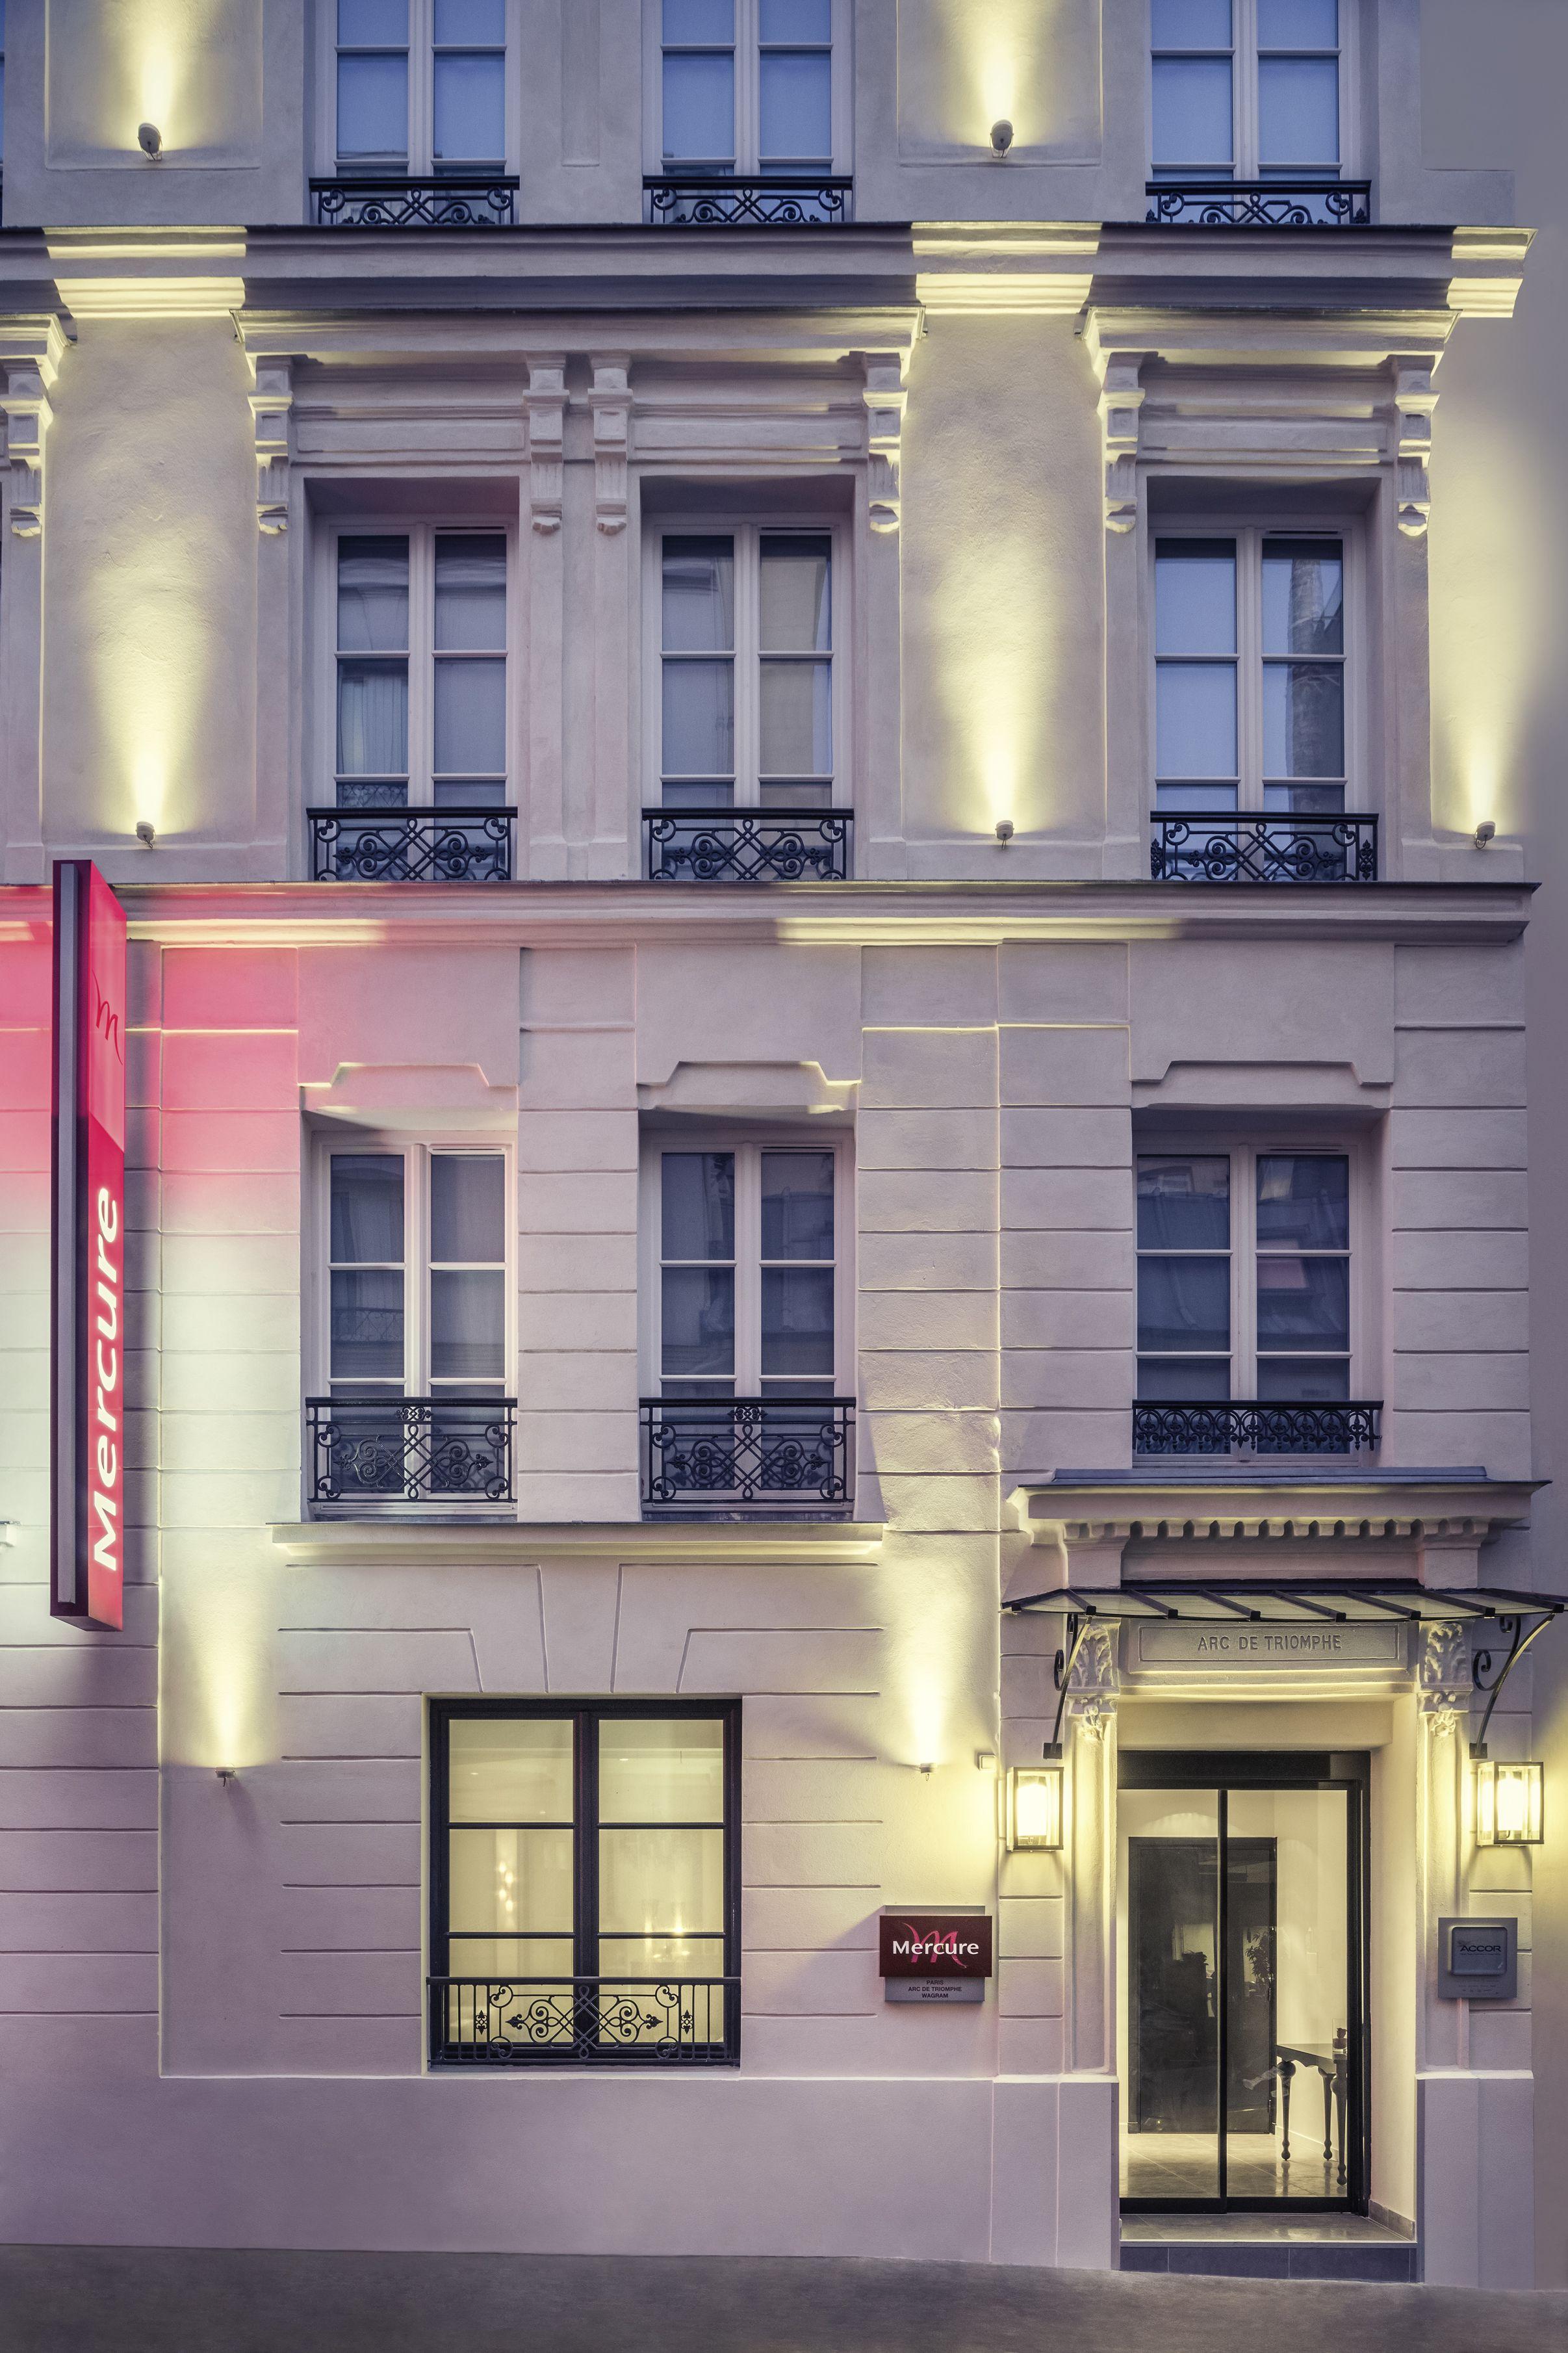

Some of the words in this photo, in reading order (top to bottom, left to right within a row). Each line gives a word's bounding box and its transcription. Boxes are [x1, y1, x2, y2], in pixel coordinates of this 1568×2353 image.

[94, 1187, 118, 1571] Mercure
[1198, 1635, 1230, 1651] ARC
[1239, 1635, 1258, 1650] DE
[1265, 1634, 1342, 1651] TRIOMPHE
[893, 1940, 979, 1955] Mercure
